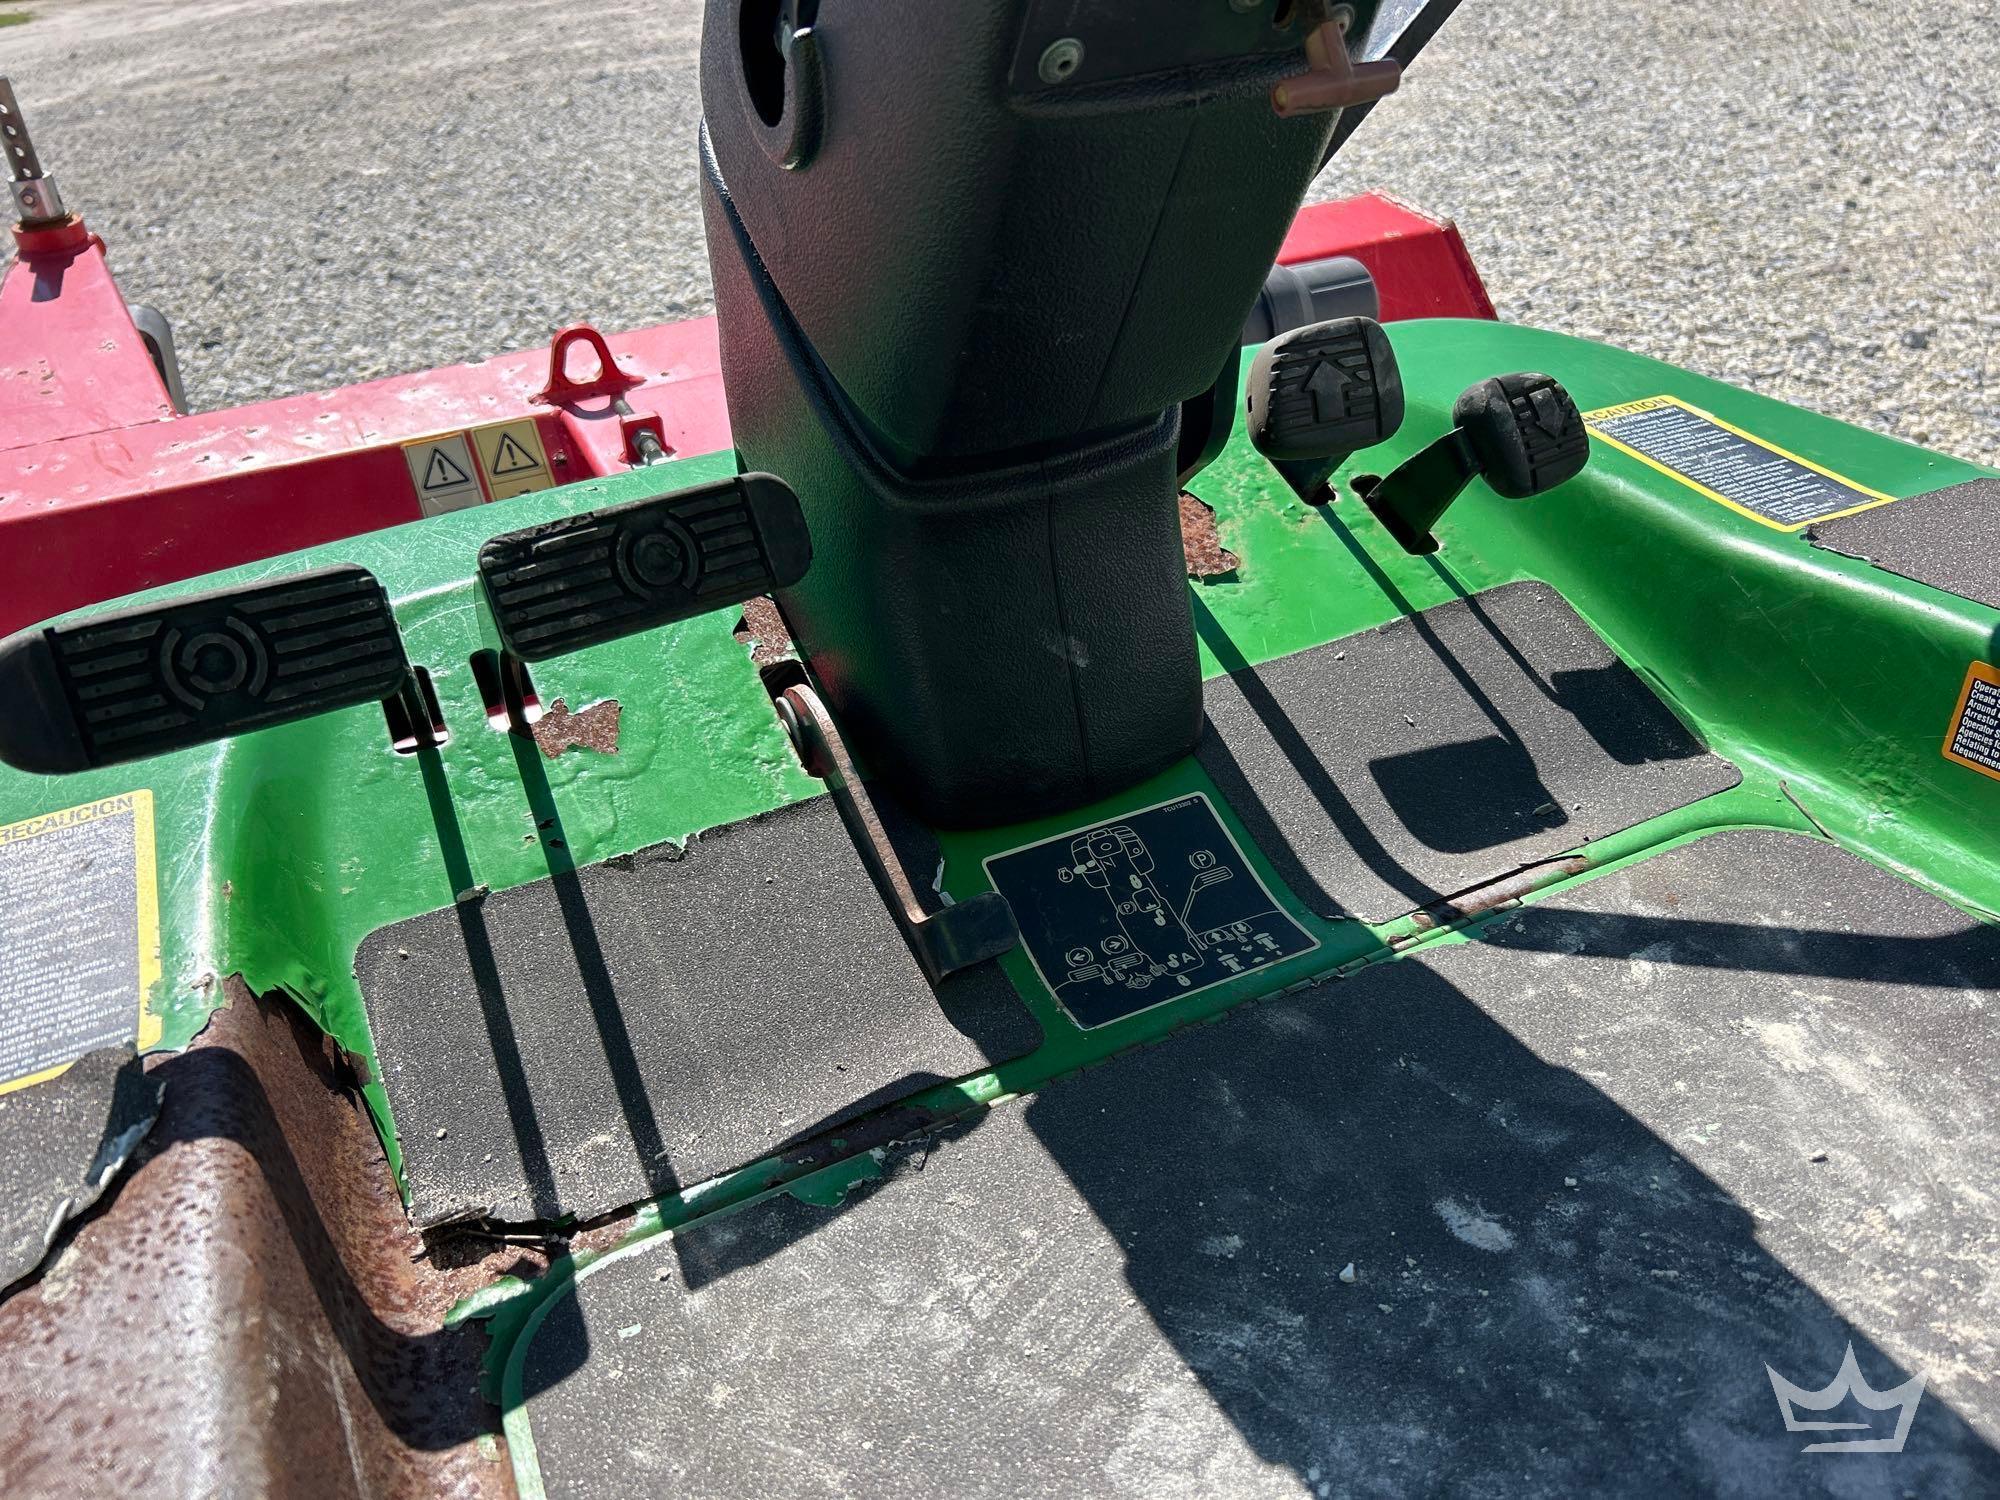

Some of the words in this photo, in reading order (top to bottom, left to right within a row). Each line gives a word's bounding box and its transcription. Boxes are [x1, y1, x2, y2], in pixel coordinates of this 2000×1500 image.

[1592, 398, 1671, 421] CAUTION
[1967, 699, 1997, 716] Around
[1971, 690, 1996, 706] Create
[1962, 717, 1994, 736] Operator
[1964, 708, 1998, 726] Arrestor
[1959, 726, 1993, 746] Agencies
[1956, 734, 1989, 756] Relating
[1991, 748, 1999, 759] to
